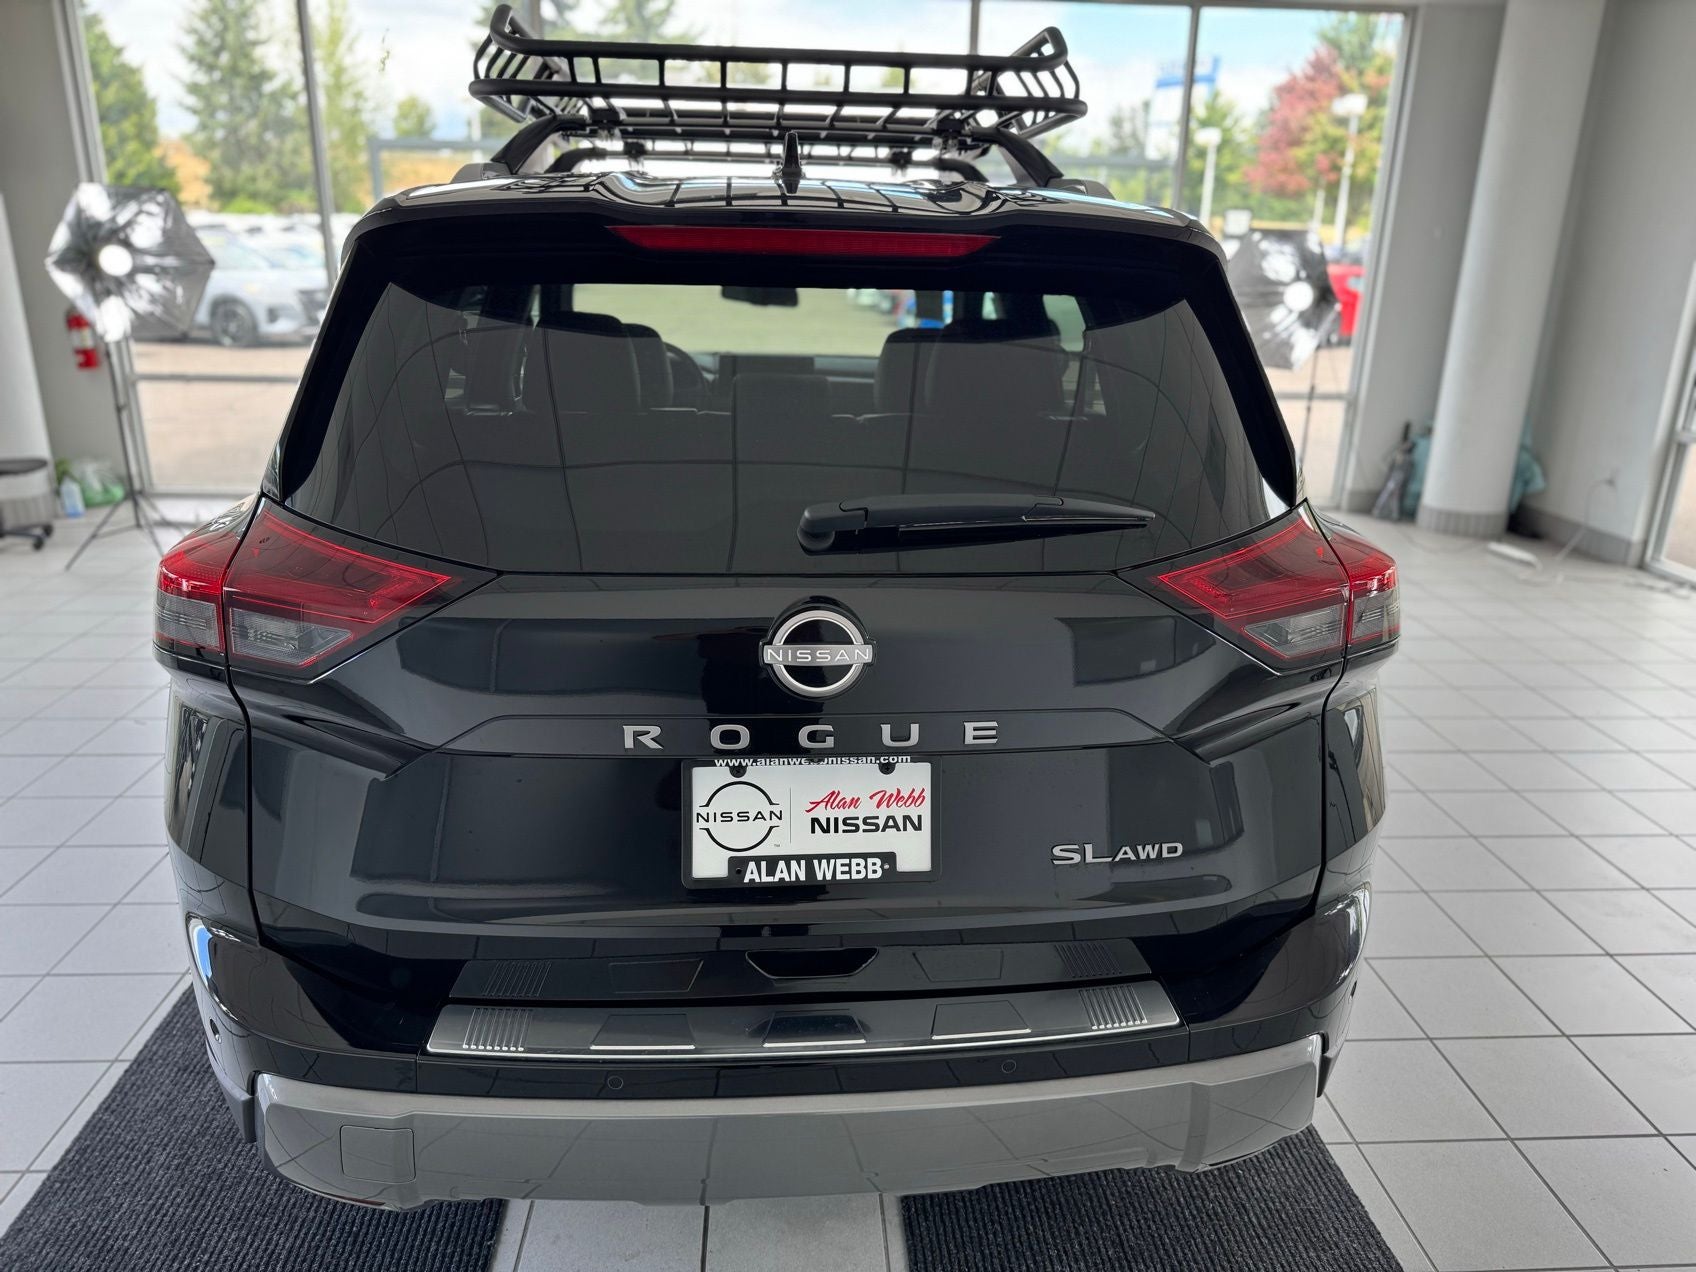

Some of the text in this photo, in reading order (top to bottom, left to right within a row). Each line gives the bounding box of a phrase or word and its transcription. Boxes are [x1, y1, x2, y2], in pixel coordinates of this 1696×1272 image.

[766, 647, 871, 663] NISSAN
[622, 721, 999, 750] ROGUE
[714, 755, 911, 767] www.alanwenissan.com
[804, 787, 926, 813] Alan Webb
[696, 810, 783, 823] NISSAN
[810, 814, 923, 834] NISSAN
[743, 857, 882, 883] ALAN WEBB
